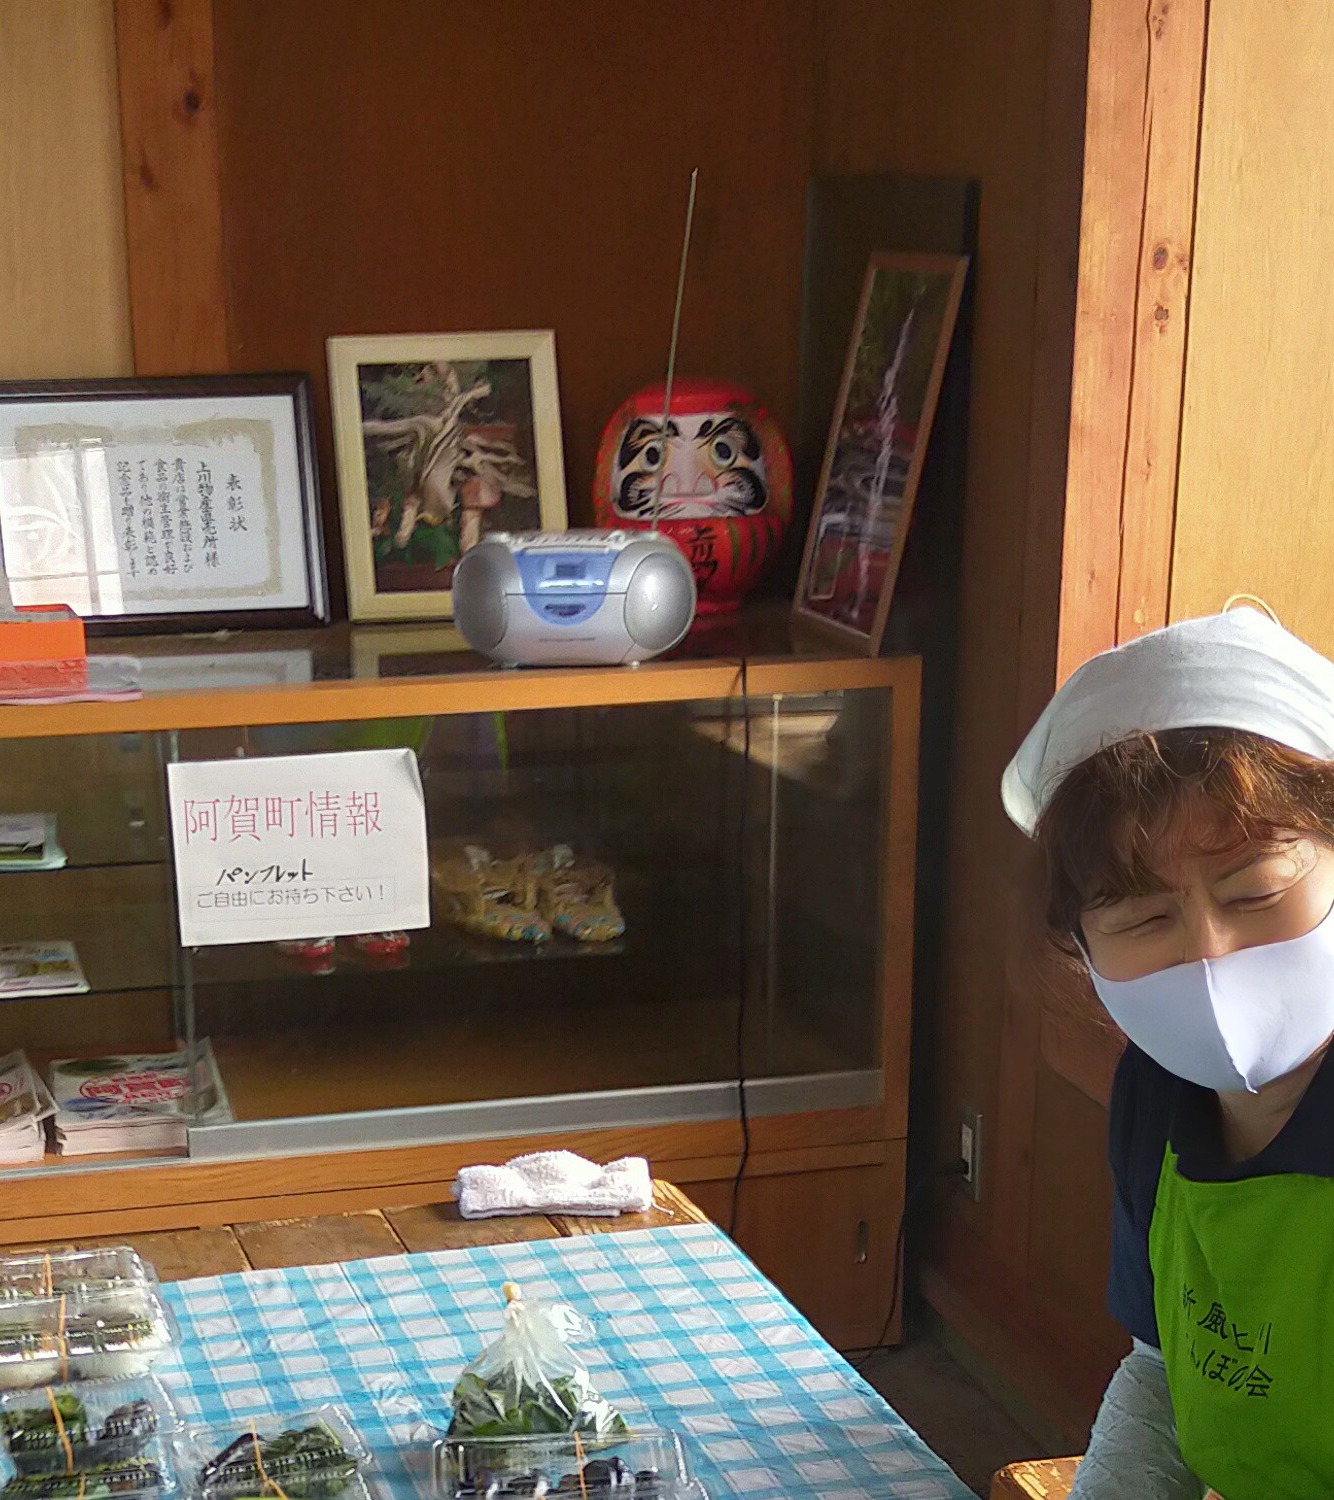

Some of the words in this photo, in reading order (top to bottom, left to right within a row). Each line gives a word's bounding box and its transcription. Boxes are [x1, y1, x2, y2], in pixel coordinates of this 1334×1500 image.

[226, 473, 248, 532] 表彰状
[183, 790, 383, 845] 阿賀町情報
